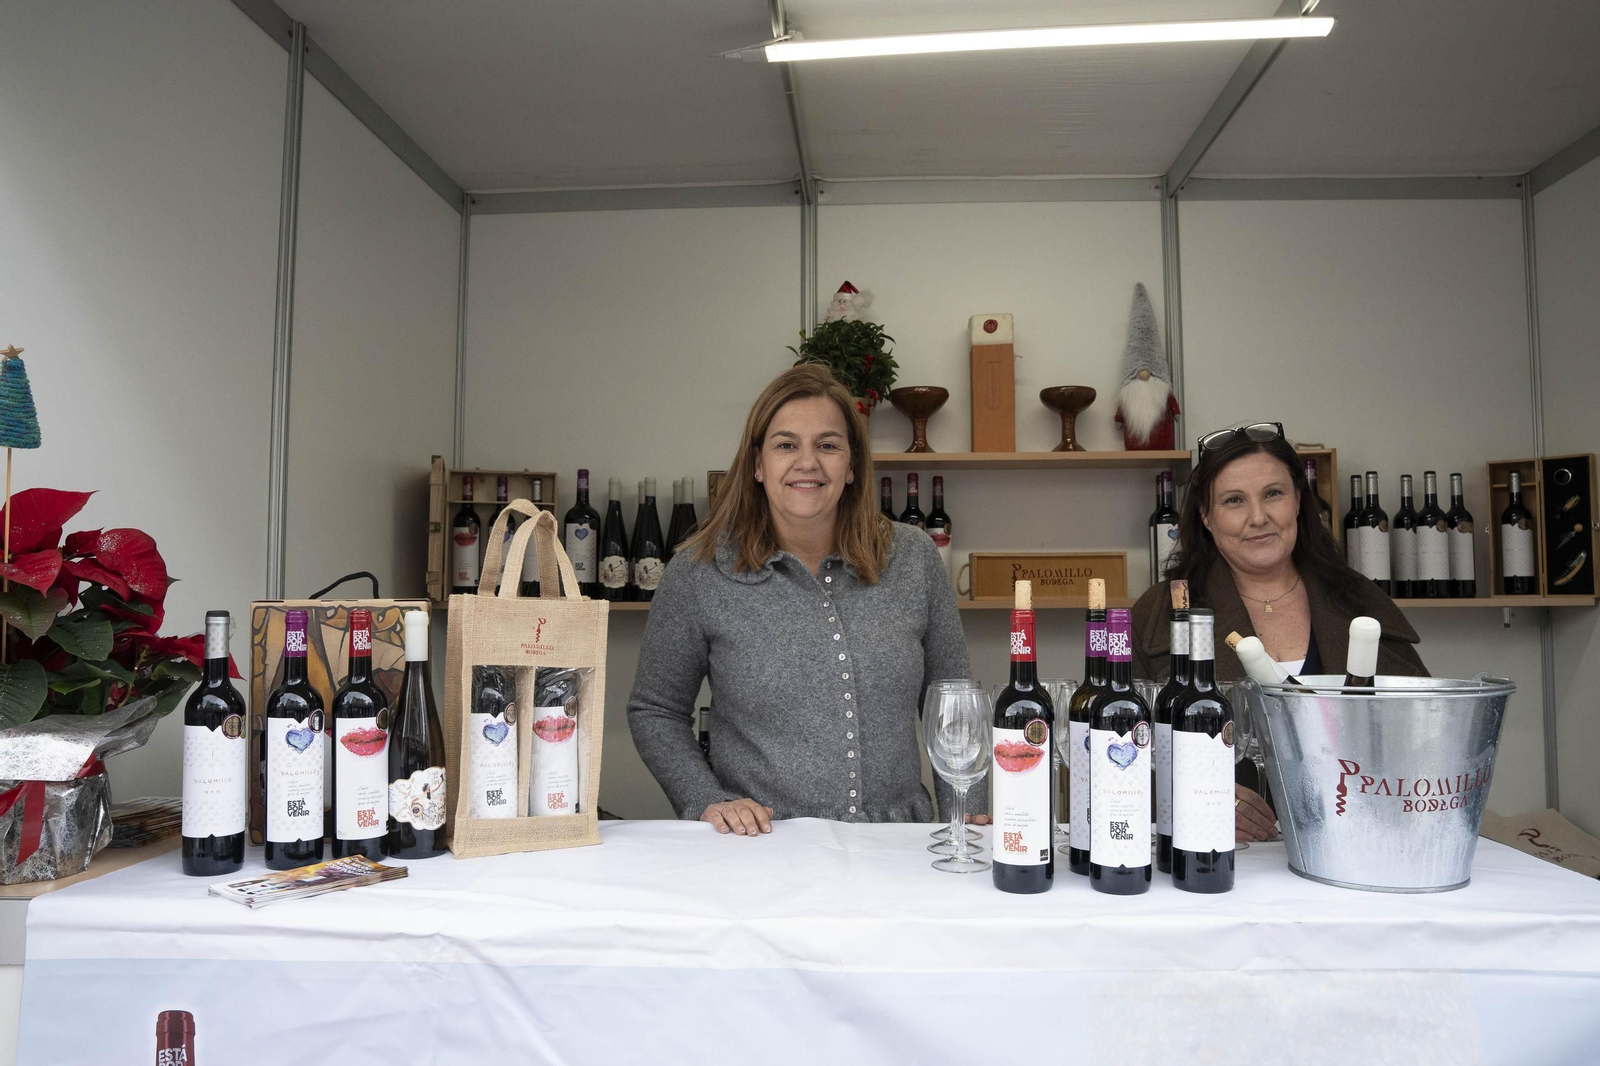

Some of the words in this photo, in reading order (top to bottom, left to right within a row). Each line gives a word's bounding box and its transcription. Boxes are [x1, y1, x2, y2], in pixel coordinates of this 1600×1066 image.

[1021, 568, 1093, 578] PALOMILLO
[287, 629, 305, 638] ESTÁ
[353, 627, 369, 637] ESTÁ
[1108, 631, 1129, 641] ESTÁ
[287, 637, 303, 645] POR
[353, 636, 368, 644] POR
[1090, 636, 1106, 645] POR
[1108, 640, 1126, 649] POR
[287, 644, 307, 652] VENIR
[353, 642, 371, 650] VENIR
[1090, 643, 1107, 651] VENI
[1108, 647, 1132, 656] VENIR
[1359, 764, 1492, 796] PALOMILLO
[487, 788, 503, 796] ESTÁ
[548, 790, 564, 799] ESTÁ
[287, 798, 306, 806] ESTÁ
[1402, 795, 1468, 813] BODEGA
[287, 804, 303, 812] POR
[357, 807, 375, 816] ESTÁ
[357, 814, 373, 822] POR
[1110, 820, 1129, 829] ESTÁ
[1004, 831, 1023, 840] ESTÁ
[1110, 827, 1127, 835] POR
[1004, 837, 1020, 846] POR
[159, 1044, 187, 1062] ESTÁ
